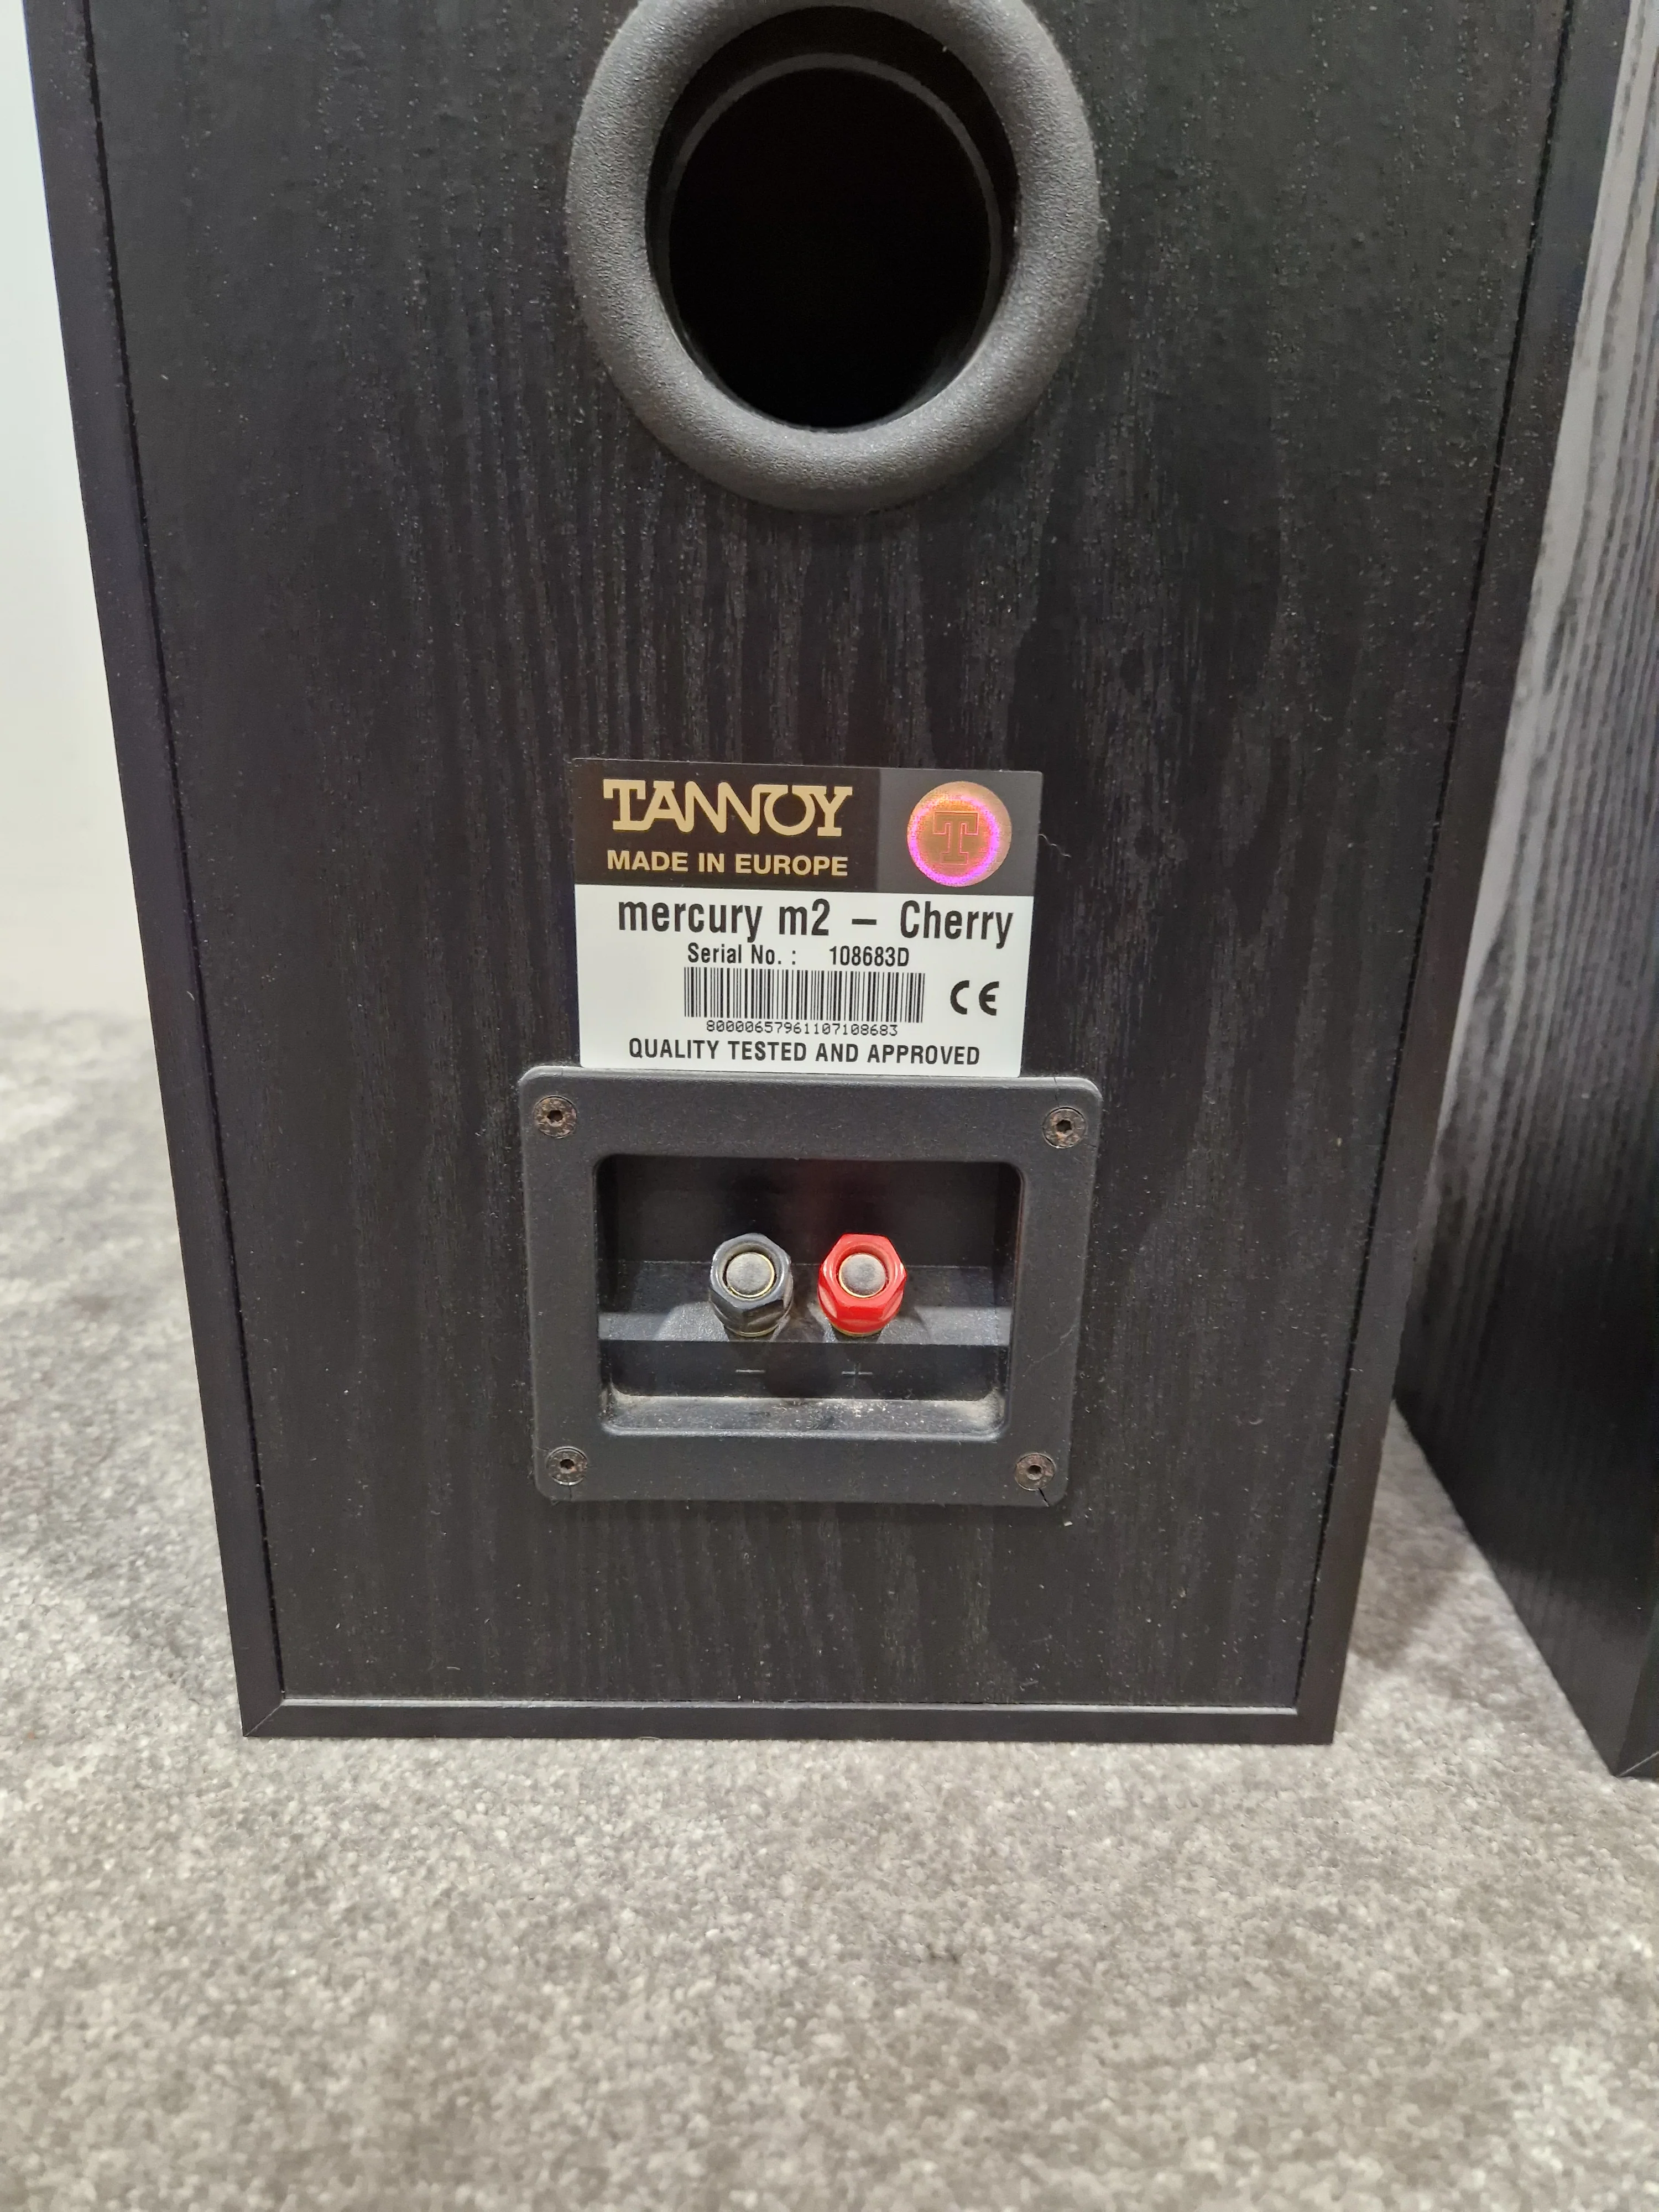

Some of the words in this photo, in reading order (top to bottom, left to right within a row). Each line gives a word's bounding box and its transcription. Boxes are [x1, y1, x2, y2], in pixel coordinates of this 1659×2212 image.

[603, 779, 853, 837] TANNOY
[607, 849, 688, 872] MADE
[698, 852, 725, 873] IN
[735, 853, 848, 877] EUROPE
[618, 901, 763, 942] mercury
[779, 898, 830, 936] m2
[900, 900, 1014, 949] Cherry
[687, 942, 742, 964] Serial
[751, 945, 782, 966] No.
[829, 945, 910, 967] 108683D
[706, 1020, 898, 1037] 80000657961107108683
[629, 1037, 719, 1060] QUALITY
[728, 1041, 806, 1062] TESTED
[815, 1043, 859, 1063] AND
[867, 1044, 980, 1066] APPROVED
